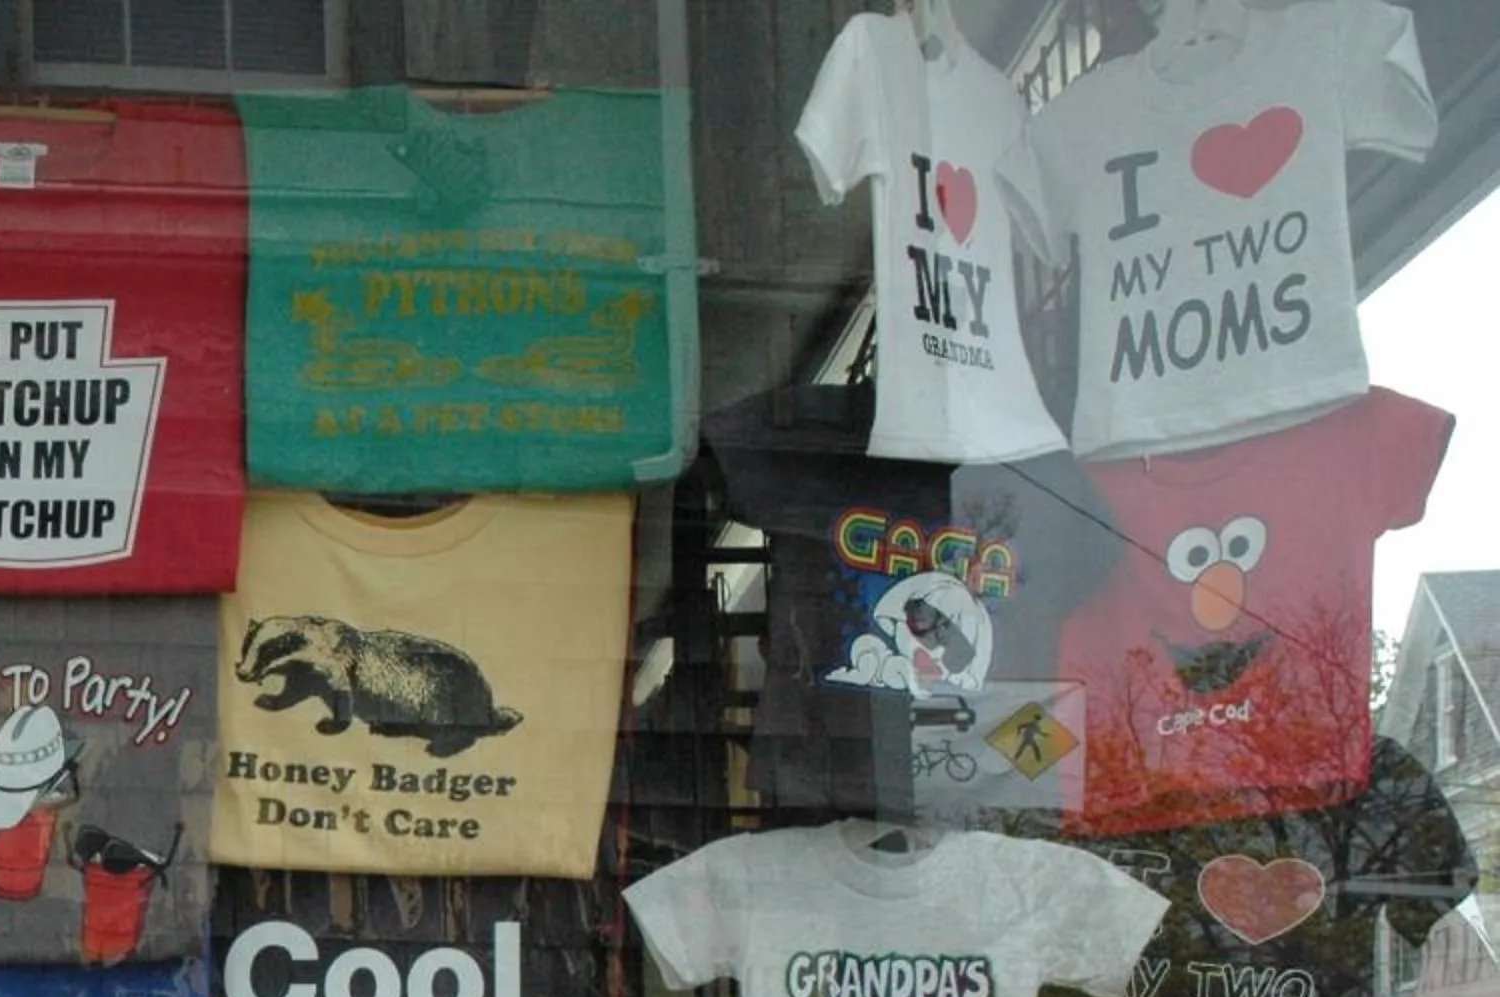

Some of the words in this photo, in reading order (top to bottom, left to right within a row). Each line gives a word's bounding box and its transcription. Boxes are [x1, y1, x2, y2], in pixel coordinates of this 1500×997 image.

[910, 152, 934, 232] I
[1105, 150, 1161, 241] I
[907, 244, 991, 338] MY
[1109, 248, 1172, 301] MY
[1194, 210, 1309, 275] TWO
[10, 320, 84, 361] PUT
[1109, 272, 1312, 383] MOMS
[32, 439, 91, 479] MY
[835, 506, 1018, 597] GAGA
[3, 664, 49, 709] To
[64, 656, 191, 744] Party!
[1209, 699, 1250, 725] Cod
[227, 752, 356, 793] Honey
[370, 764, 516, 802] Badger
[256, 798, 371, 833] Don't
[384, 809, 480, 840] Care
